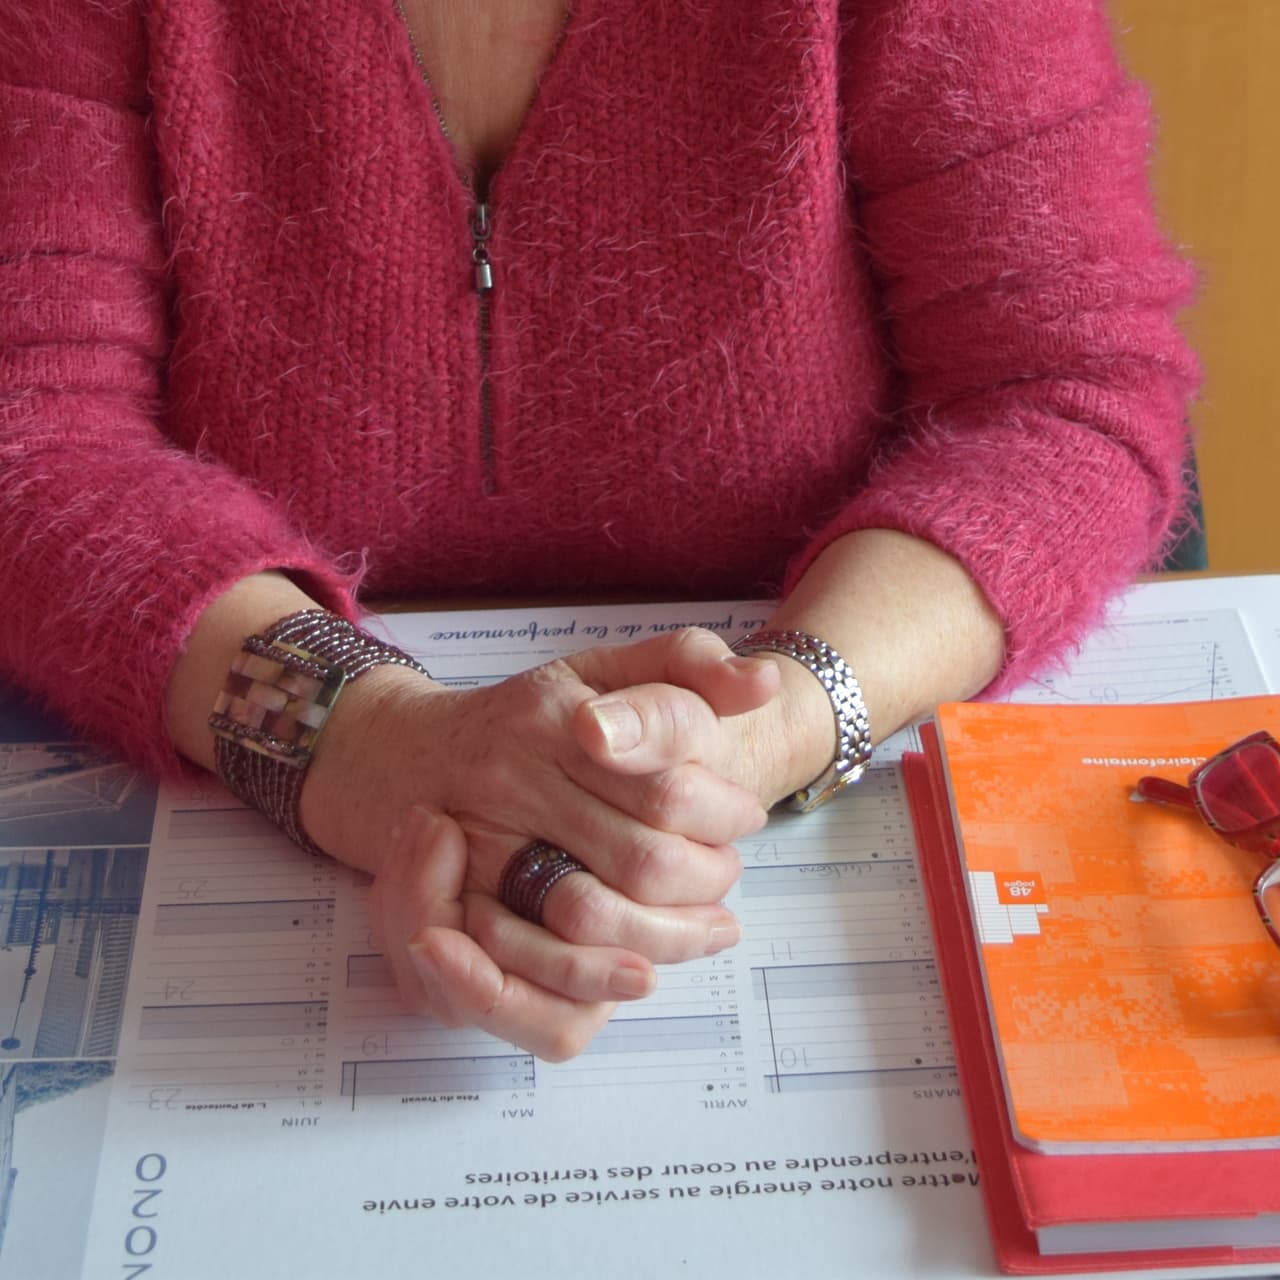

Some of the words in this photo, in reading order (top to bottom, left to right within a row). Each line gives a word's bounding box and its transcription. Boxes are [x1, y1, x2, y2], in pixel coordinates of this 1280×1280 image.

[428, 619, 577, 641] performance
[580, 625, 609, 639] la
[614, 623, 643, 638] de
[752, 842, 782, 862] 12
[1002, 879, 1037, 889] pages
[1009, 885, 1033, 898] 48
[768, 941, 796, 962] 11
[360, 1033, 391, 1057] 19
[779, 1046, 810, 1070] 10
[147, 1087, 183, 1111] 23
[401, 1095, 438, 1105] Travail
[439, 1095, 455, 1103] du
[911, 1087, 963, 1101] MARS
[185, 1102, 239, 1113] Pentecôte
[501, 1107, 535, 1119] MAI
[699, 1098, 748, 1110] AVRIL
[281, 1115, 321, 1127] JUIN
[606, 1164, 654, 1185] des
[660, 1160, 737, 1180] coeur
[743, 1159, 778, 1176] au
[463, 1167, 600, 1189] territoires
[820, 1176, 894, 1193] notre
[563, 1187, 662, 1208] service
[667, 1185, 703, 1202] au
[708, 1177, 813, 1202] énergie
[360, 1197, 438, 1217] envie
[442, 1194, 517, 1214] votre
[522, 1191, 559, 1211] de
